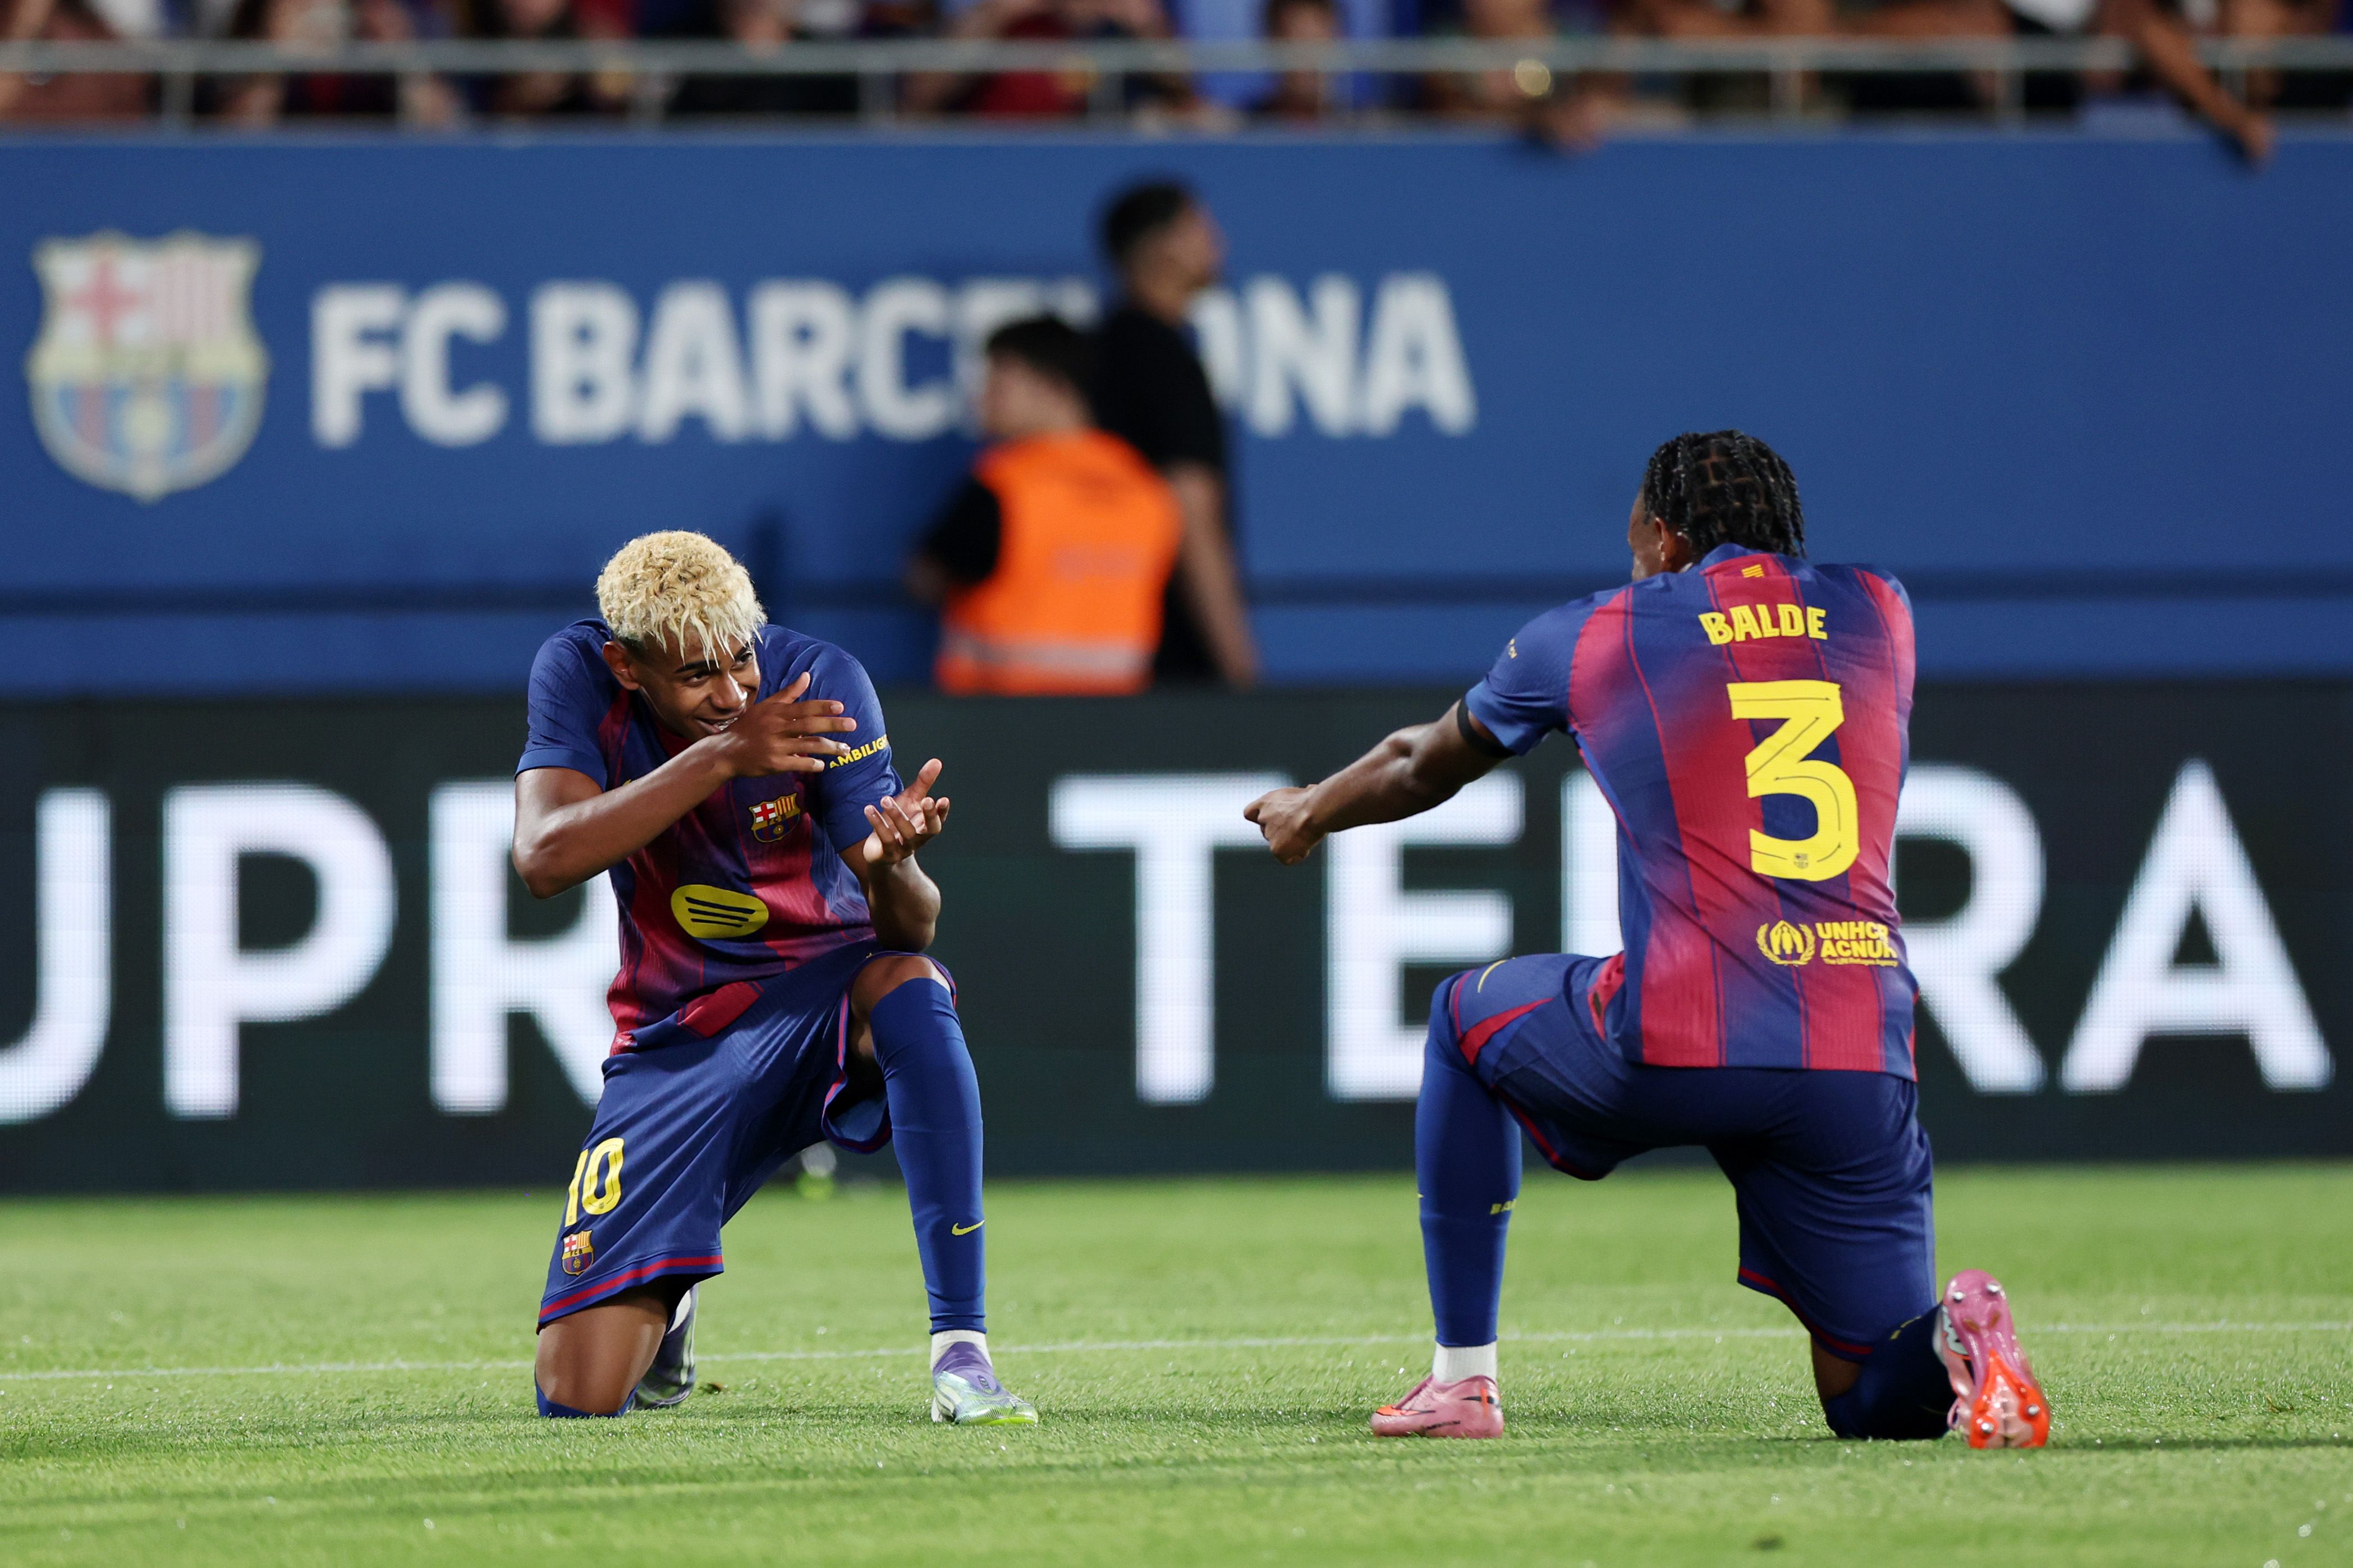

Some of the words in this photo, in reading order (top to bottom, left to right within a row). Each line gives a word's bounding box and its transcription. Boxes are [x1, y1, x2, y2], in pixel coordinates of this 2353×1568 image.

[310, 282, 508, 447] FC
[529, 275, 1477, 444] BARCENA
[1698, 603, 1828, 645] BALDE
[1726, 679, 1860, 882] 3
[1049, 760, 2334, 1102] TERA
[565, 1137, 625, 1227] 10
